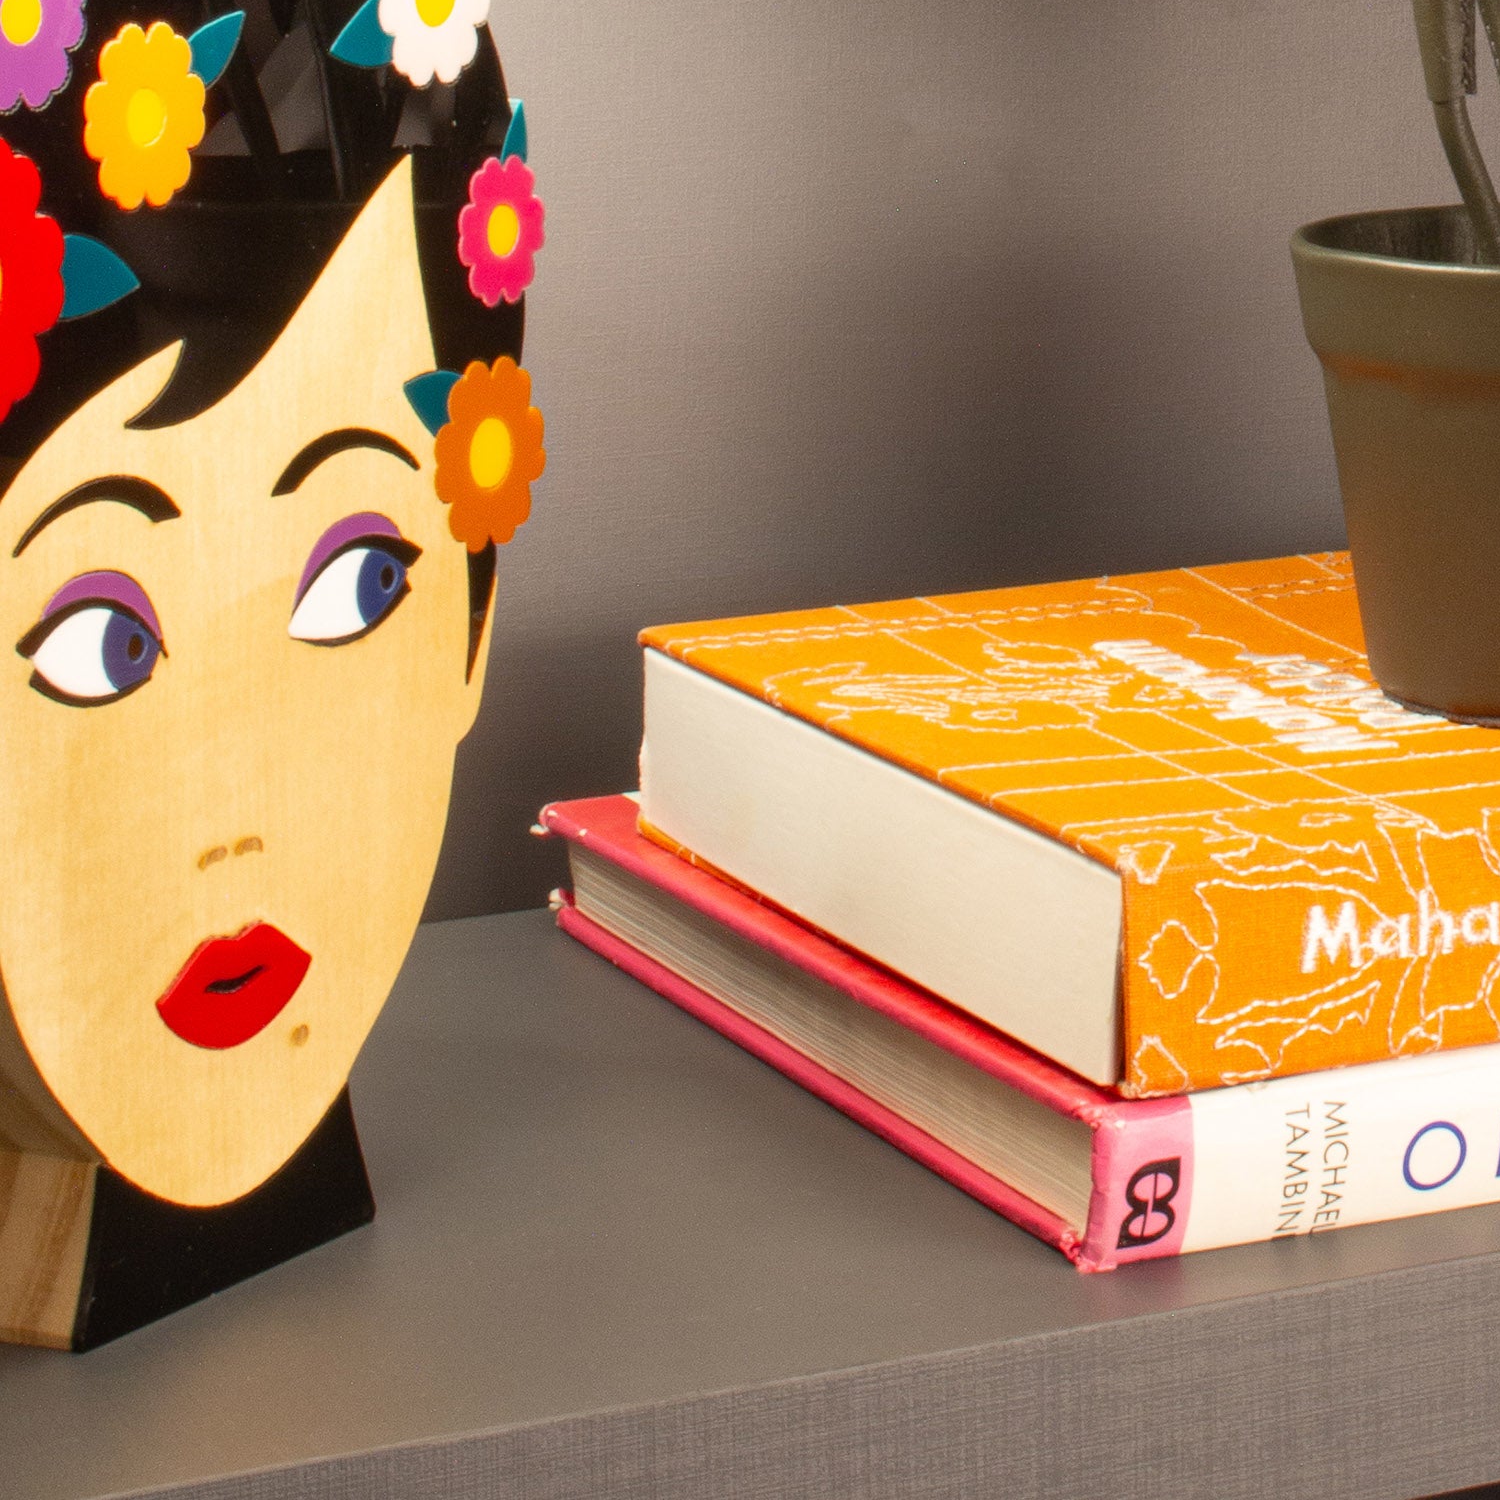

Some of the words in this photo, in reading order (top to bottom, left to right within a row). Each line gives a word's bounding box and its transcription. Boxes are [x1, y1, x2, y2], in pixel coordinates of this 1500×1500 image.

[1091, 639, 1399, 754] Maharam
[1308, 1100, 1350, 1234] MICHAEL
[1402, 1120, 1468, 1192] O
